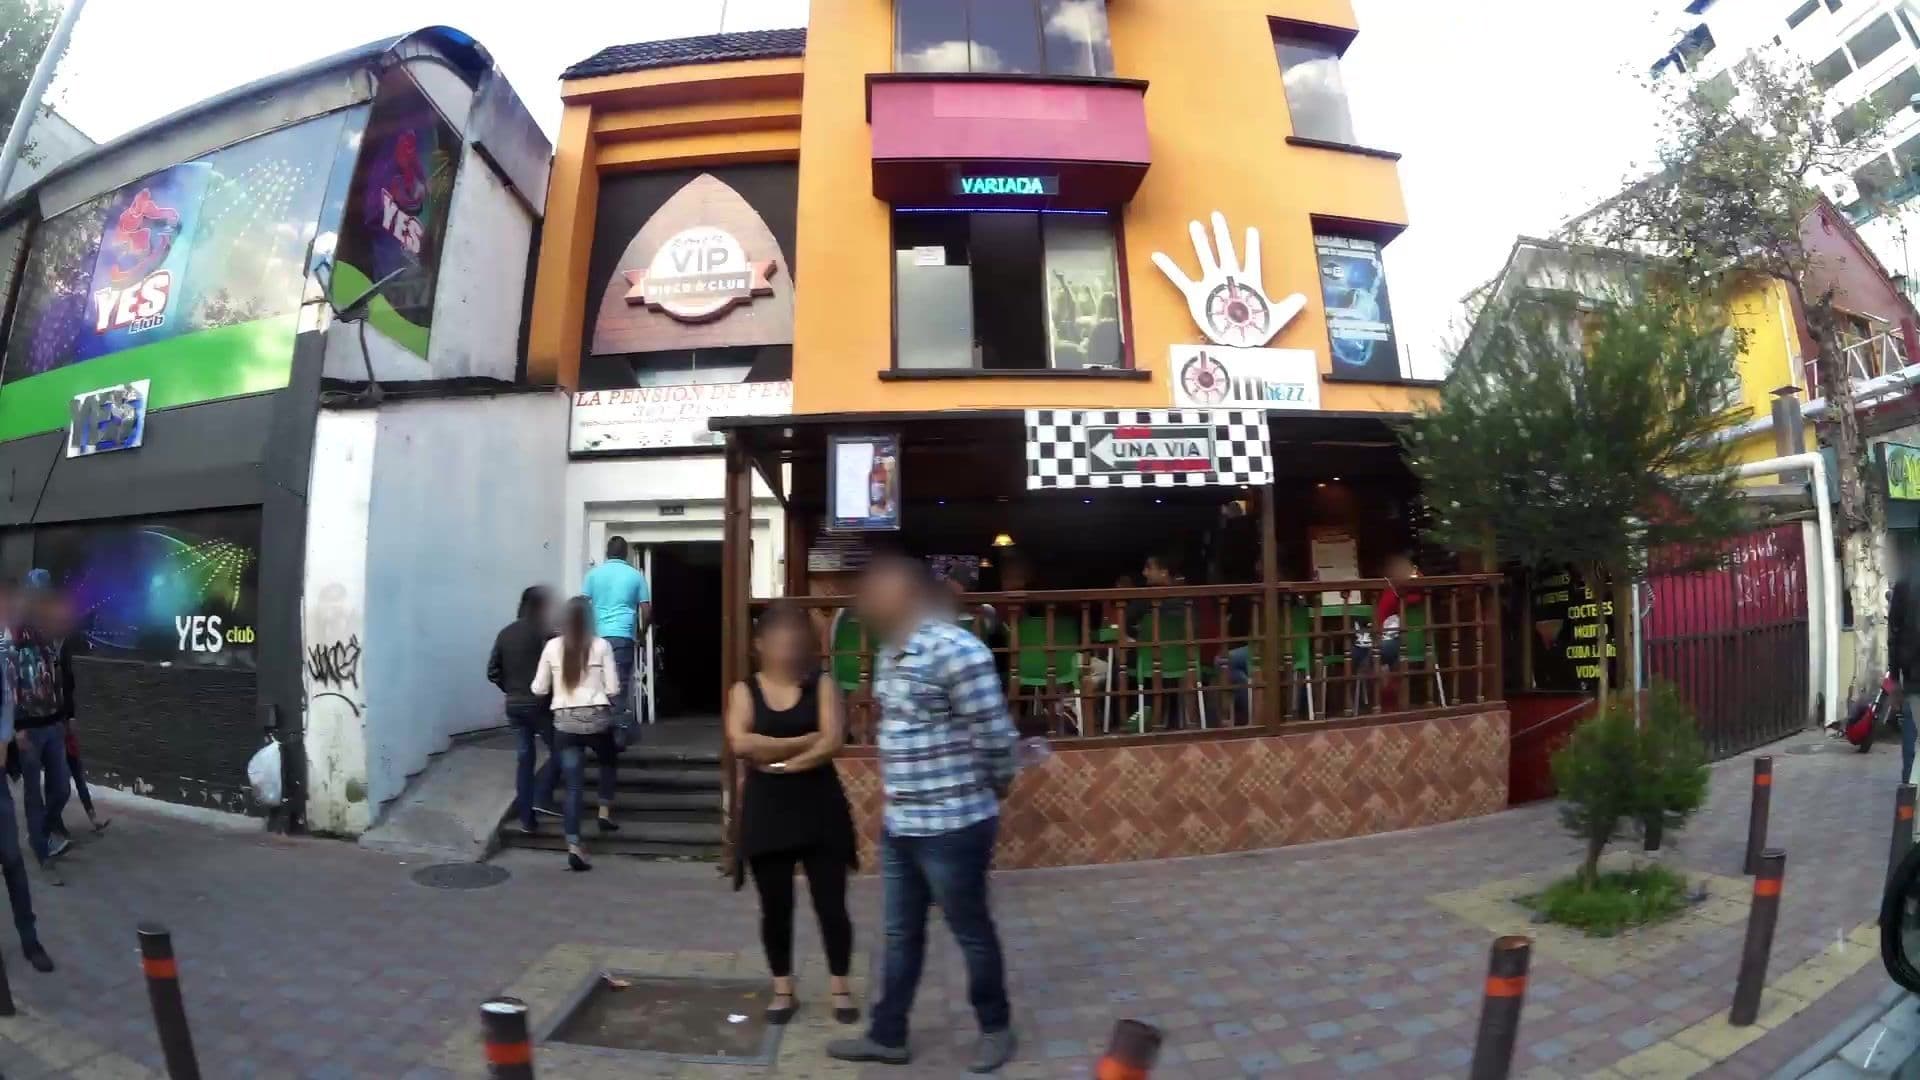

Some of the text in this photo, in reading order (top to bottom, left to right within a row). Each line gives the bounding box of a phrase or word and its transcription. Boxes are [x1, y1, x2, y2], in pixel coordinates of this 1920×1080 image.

[961, 178, 1043, 194] VARIADA
[381, 188, 422, 255] YES
[670, 247, 729, 272] VIP
[708, 278, 745, 291] CLUB
[95, 272, 171, 333] YES
[576, 391, 601, 407] LA
[607, 386, 702, 405] PENSION
[711, 384, 738, 400] DE
[1113, 441, 1201, 458] UNA VIA
[1567, 601, 1613, 619] COCTEES
[175, 615, 255, 652] YES club
